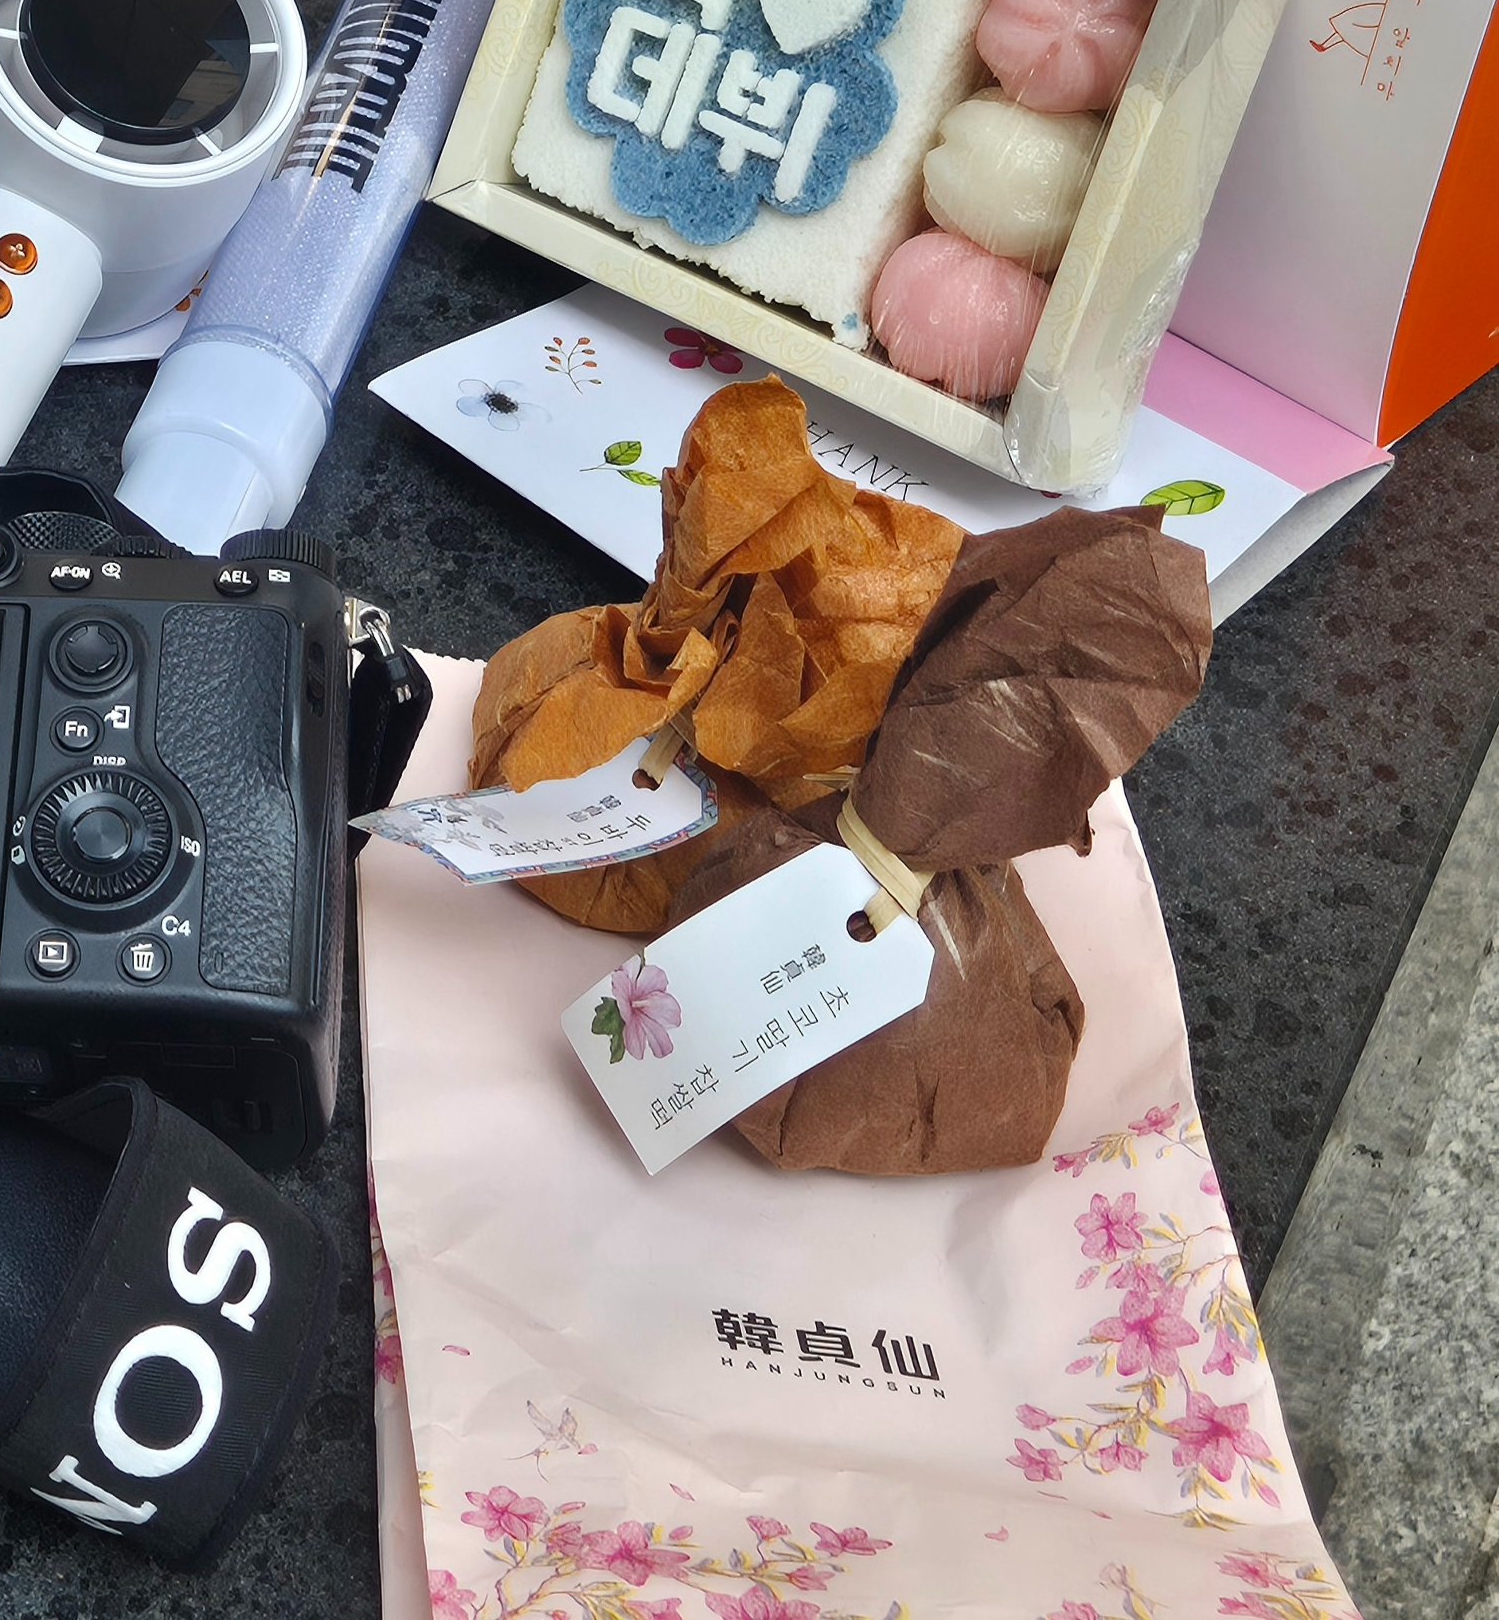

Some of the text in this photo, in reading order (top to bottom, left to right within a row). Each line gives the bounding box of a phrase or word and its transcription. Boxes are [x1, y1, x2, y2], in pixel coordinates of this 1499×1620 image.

[587, 6, 837, 203] 데뷔
[806, 421, 930, 501] HANK
[219, 569, 253, 586] AEL
[64, 720, 89, 738] Fn
[180, 835, 201, 857] ISO
[161, 915, 192, 937] C4
[651, 986, 850, 1130] 초코딸기 찹쌀떡
[712, 1308, 941, 1381] 韓貞仙
